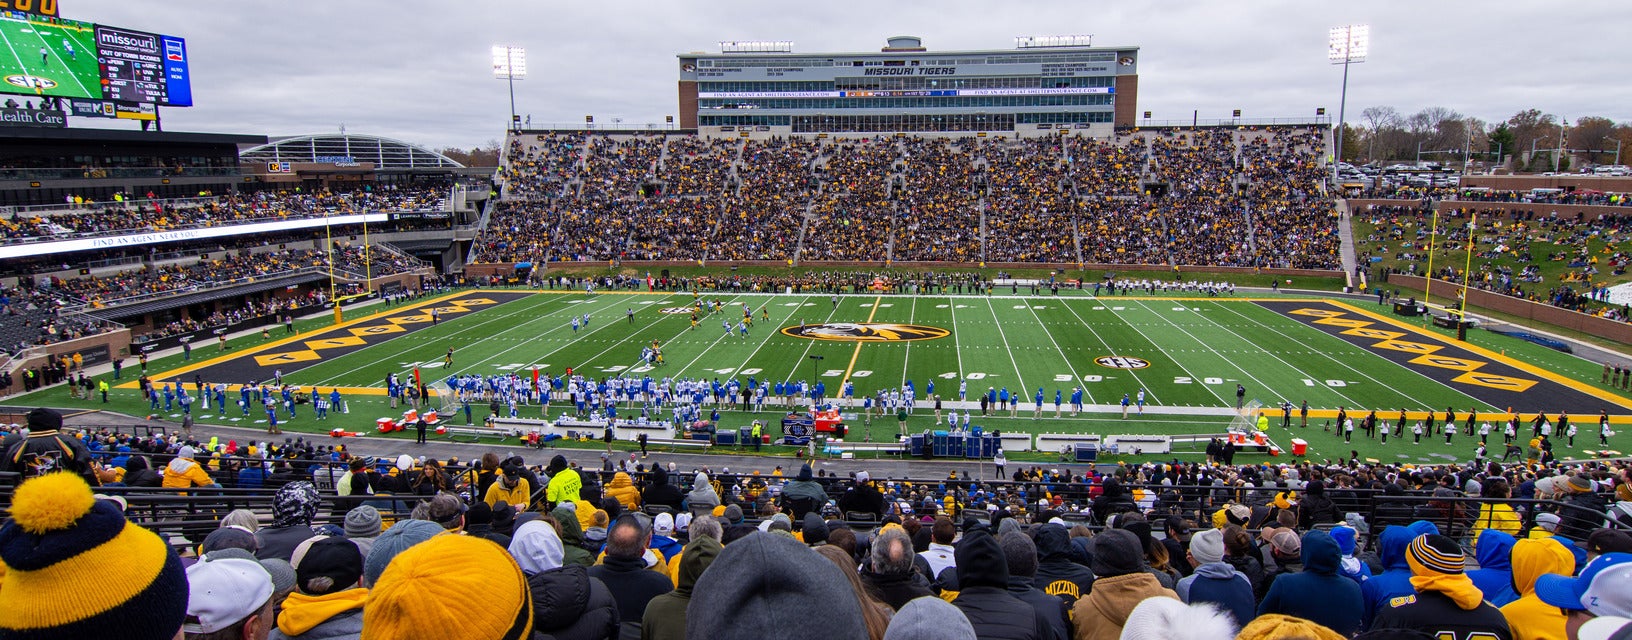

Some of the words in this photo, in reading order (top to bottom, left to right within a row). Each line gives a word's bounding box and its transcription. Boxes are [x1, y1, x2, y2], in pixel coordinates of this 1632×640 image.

[101, 32, 154, 48] missouri
[140, 54, 161, 62] SCORES
[919, 67, 956, 75] TIGERS
[36, 112, 63, 124] Care
[93, 238, 114, 246] FIND
[132, 234, 157, 243] AGENT
[821, 369, 873, 377] 50
[938, 372, 987, 380] 40
[1053, 374, 1103, 382] 30
[1173, 376, 1224, 385] 20
[1301, 378, 1347, 387] 10
[1045, 580, 1079, 599] MIZZOU
